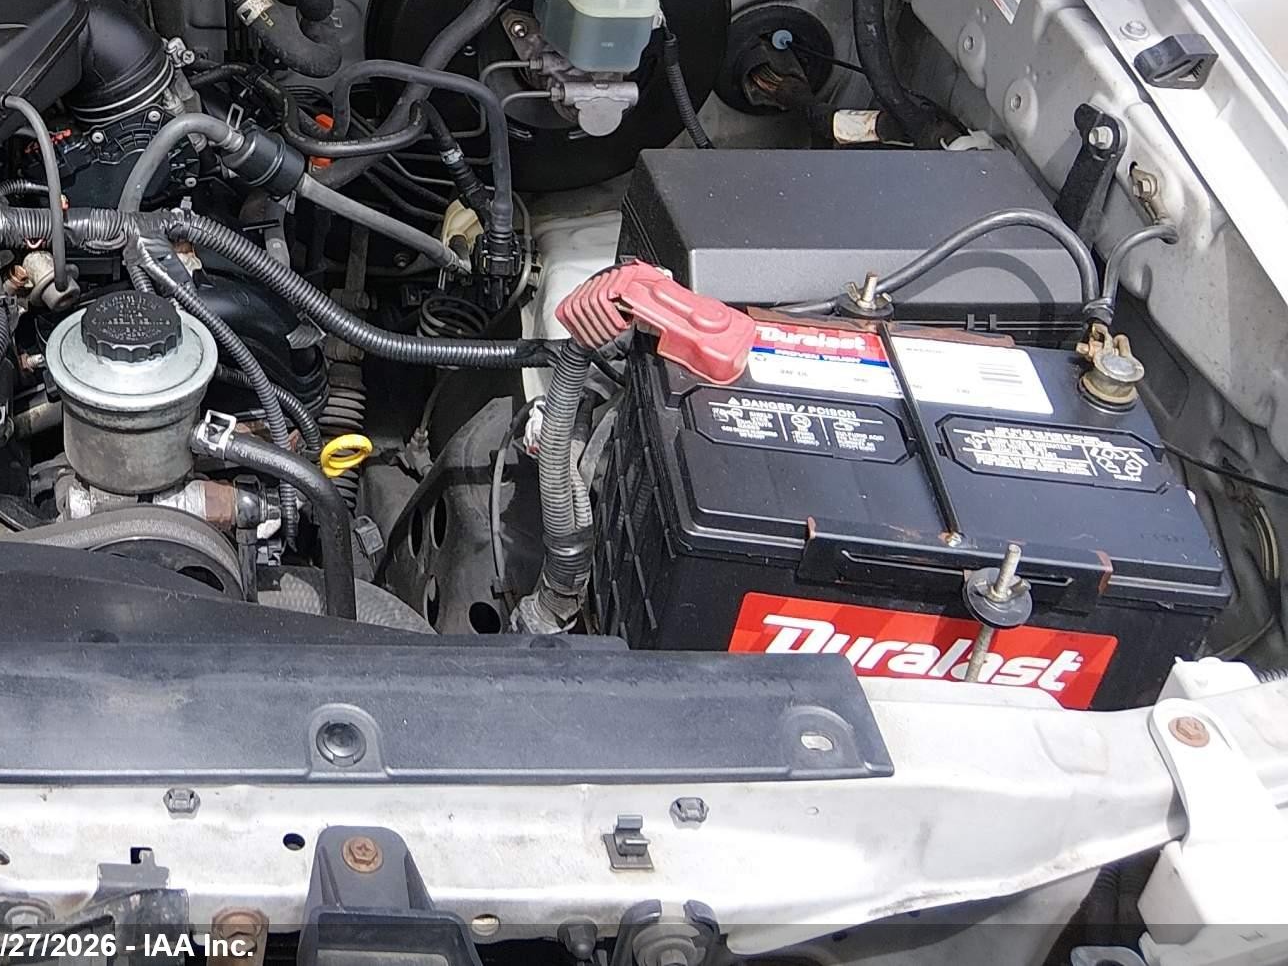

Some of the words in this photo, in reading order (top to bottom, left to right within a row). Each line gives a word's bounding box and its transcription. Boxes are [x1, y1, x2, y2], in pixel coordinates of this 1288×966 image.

[741, 398, 795, 412] DANGER
[807, 405, 857, 418] POISON
[762, 614, 1083, 691] Duralast
